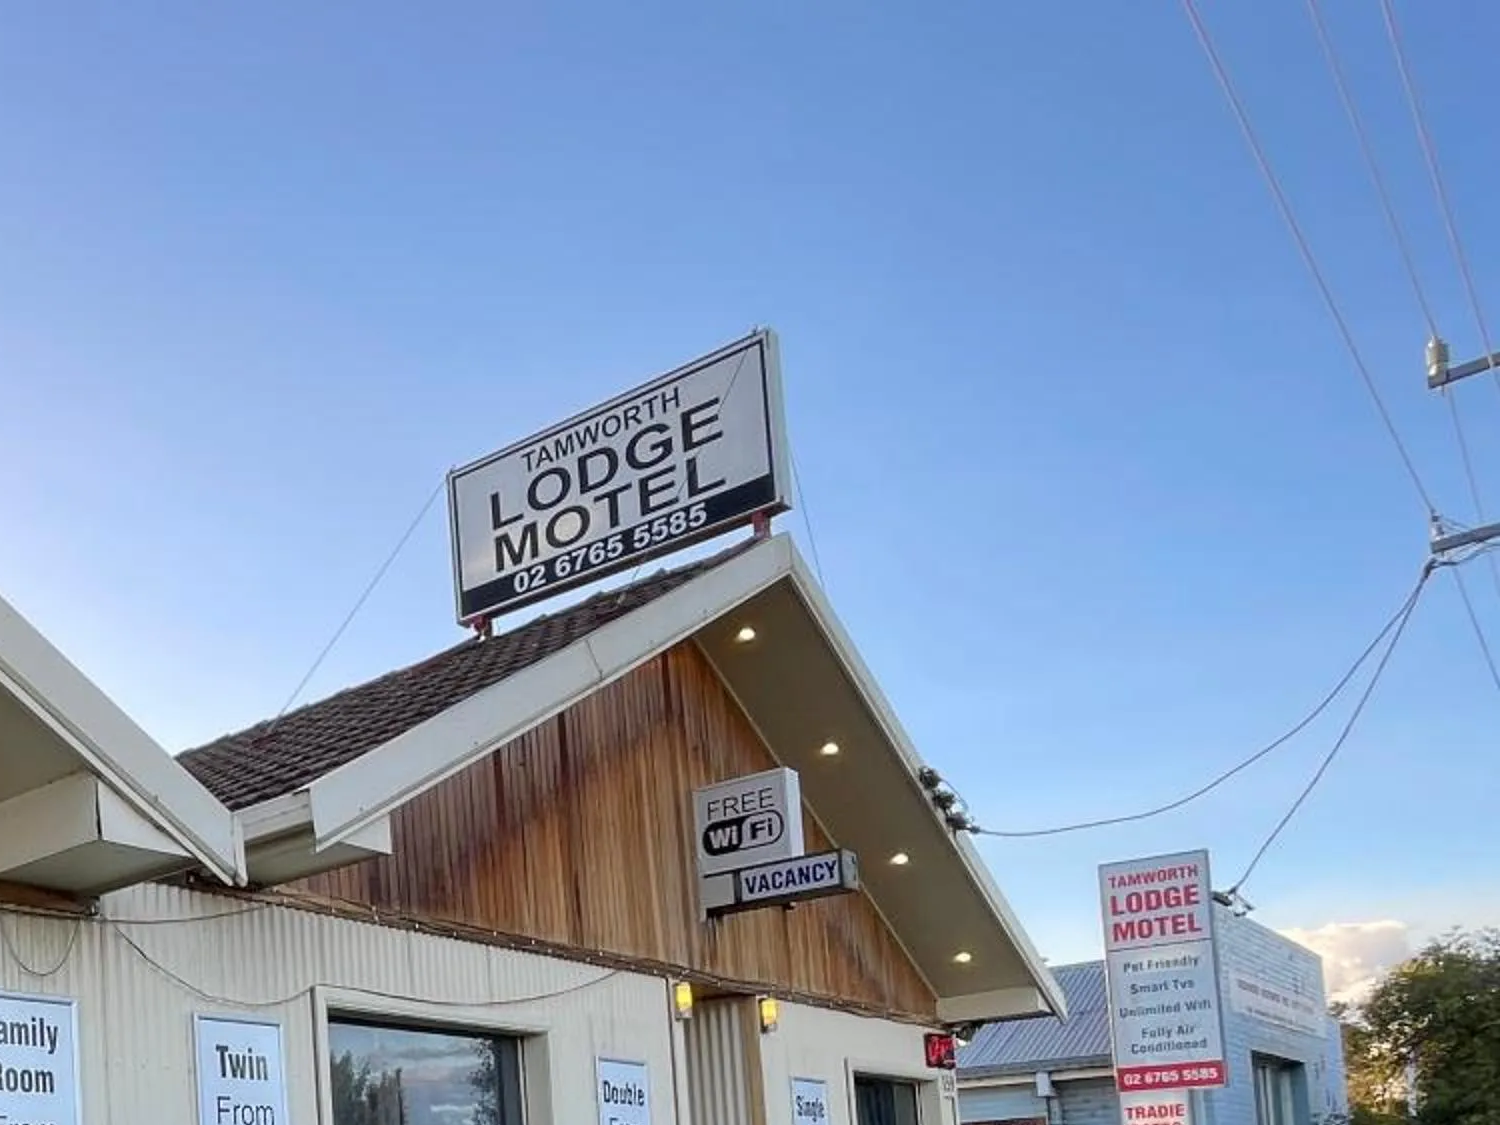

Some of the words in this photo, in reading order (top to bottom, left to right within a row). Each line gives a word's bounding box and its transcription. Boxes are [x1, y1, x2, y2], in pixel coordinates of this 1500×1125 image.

[521, 387, 681, 473] TAMWORTH
[489, 397, 724, 531] LODGE
[495, 457, 727, 573] MOTEL
[513, 565, 547, 594] 02
[554, 535, 624, 577] 6765
[633, 502, 707, 549] 5585
[707, 787, 775, 821] FREE
[745, 860, 838, 895] VACANCY
[1108, 864, 1198, 889] TAMWORTH
[1110, 884, 1199, 916] LODGE
[1112, 912, 1202, 942] MOTEL
[1130, 981, 1169, 995] Smart
[1119, 1003, 1180, 1018] Unlimited
[1131, 1038, 1208, 1055] Conditioned
[216, 1044, 268, 1081] Twin
[1123, 1073, 1142, 1086] 02
[1144, 1070, 1179, 1084] 6765
[603, 1080, 645, 1107] Double
[796, 1095, 825, 1122] Single
[1125, 1103, 1186, 1120] TRADIE
